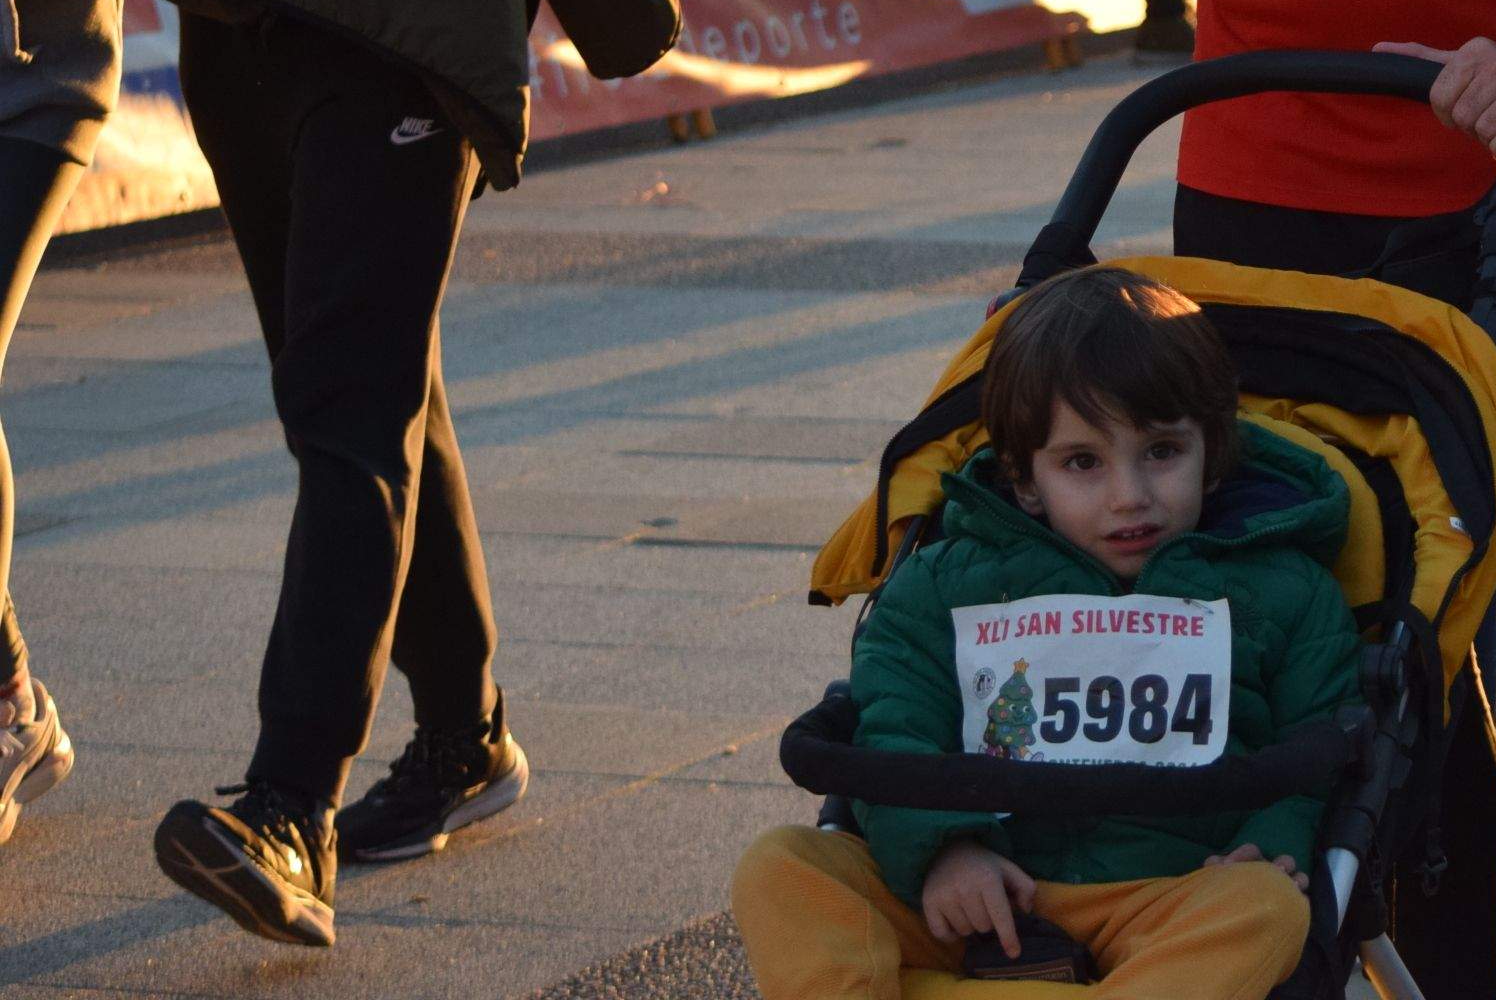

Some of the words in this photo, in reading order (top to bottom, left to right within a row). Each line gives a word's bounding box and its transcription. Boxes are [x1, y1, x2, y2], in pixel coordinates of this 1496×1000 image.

[399, 116, 435, 133] NIKE
[975, 618, 1010, 645] XLI
[1014, 610, 1062, 638] SAN
[1071, 609, 1205, 637] SILVESTRE
[1039, 673, 1213, 746] 5984
